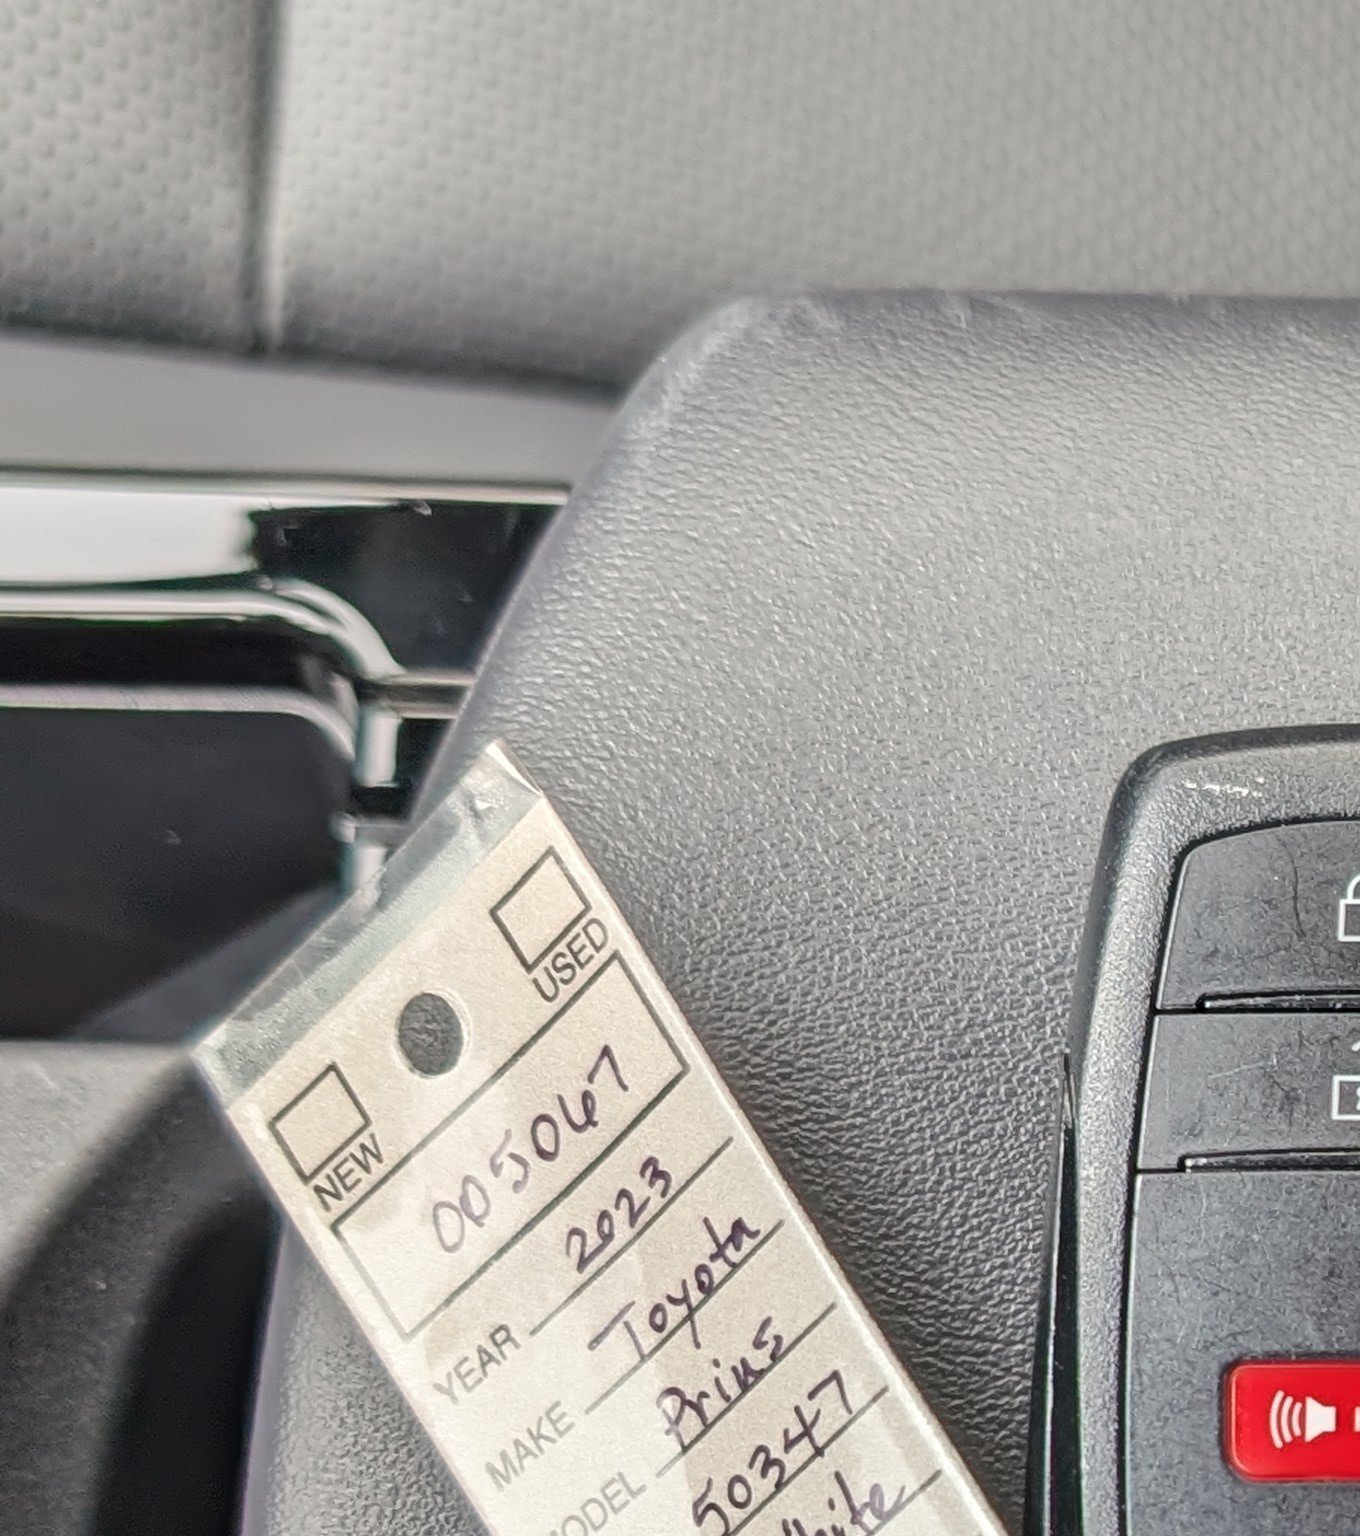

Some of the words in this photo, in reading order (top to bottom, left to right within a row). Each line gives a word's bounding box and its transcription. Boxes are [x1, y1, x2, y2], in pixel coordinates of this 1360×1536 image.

[531, 917, 610, 1003] USED
[313, 1133, 385, 1212] NEW
[432, 1045, 629, 1253] 005067
[433, 1323, 521, 1406] YEAR
[566, 1157, 672, 1273] 2023
[486, 1402, 575, 1492] MAKE
[587, 1216, 761, 1361] Toyota
[655, 1316, 785, 1453] Prius
